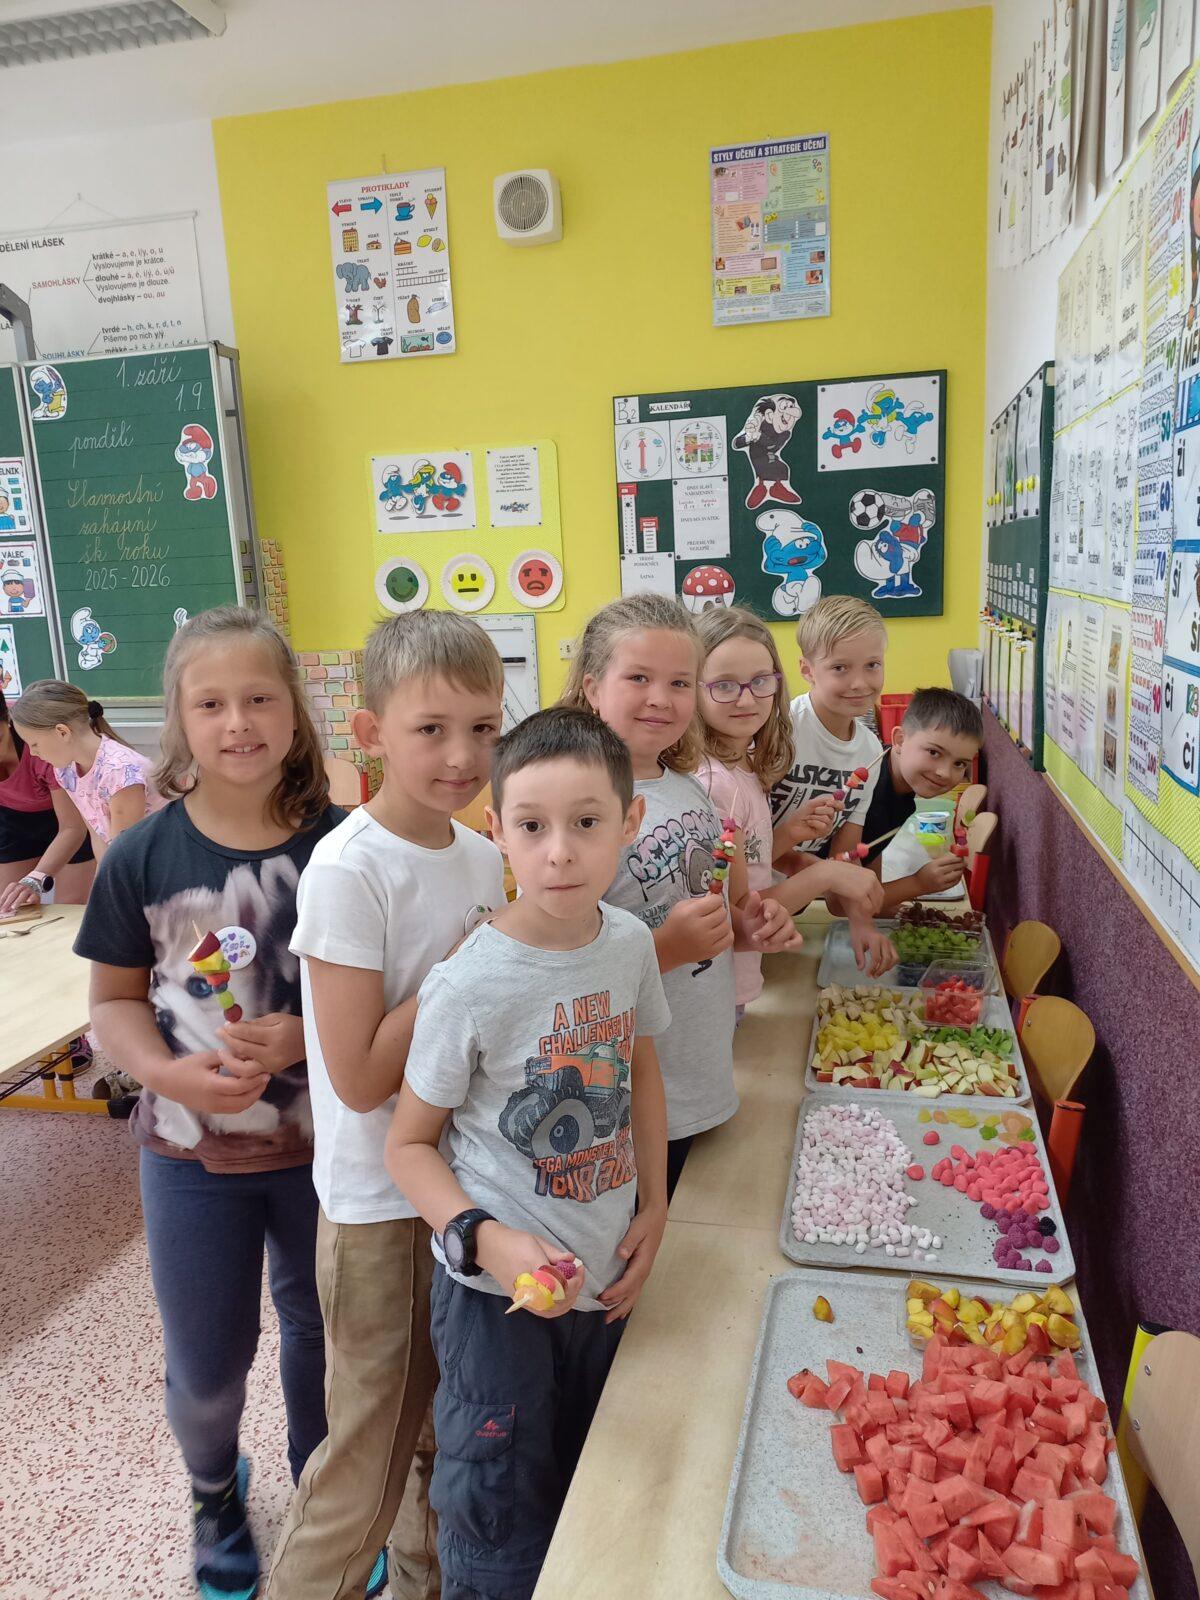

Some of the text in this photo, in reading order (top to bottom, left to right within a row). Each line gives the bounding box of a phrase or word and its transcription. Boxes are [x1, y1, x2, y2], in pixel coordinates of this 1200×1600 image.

[714, 138, 825, 163] STYLY UČENÍ A STRATEGIE UČENÍ
[361, 181, 410, 193] PROTIKLADY
[32, 236, 64, 249] HLÁSEK
[93, 260, 134, 271] Vyslovujeme
[95, 273, 119, 282] dlouhé
[32, 276, 80, 289] SAMOHLÁSKY
[96, 281, 137, 292] Vyslovujeme
[98, 294, 135, 304] dvojhlásky
[139, 332, 153, 340] nich
[134, 355, 182, 387] září
[1161, 410, 1170, 441] 50
[69, 420, 133, 468] pondělí
[68, 474, 164, 508] Slavnostní
[1160, 481, 1170, 511] 60
[79, 507, 157, 550] zahájení
[120, 533, 170, 561] roku
[1156, 551, 1166, 580] 70
[1154, 619, 1163, 648] 80
[1153, 684, 1161, 714] 90
[793, 788, 804, 805] NYC
[553, 990, 610, 1032] A NEW
[539, 1015, 621, 1056] CHALLENGER
[566, 1140, 616, 1169] MONSTER
[535, 1162, 597, 1204] TOUR
